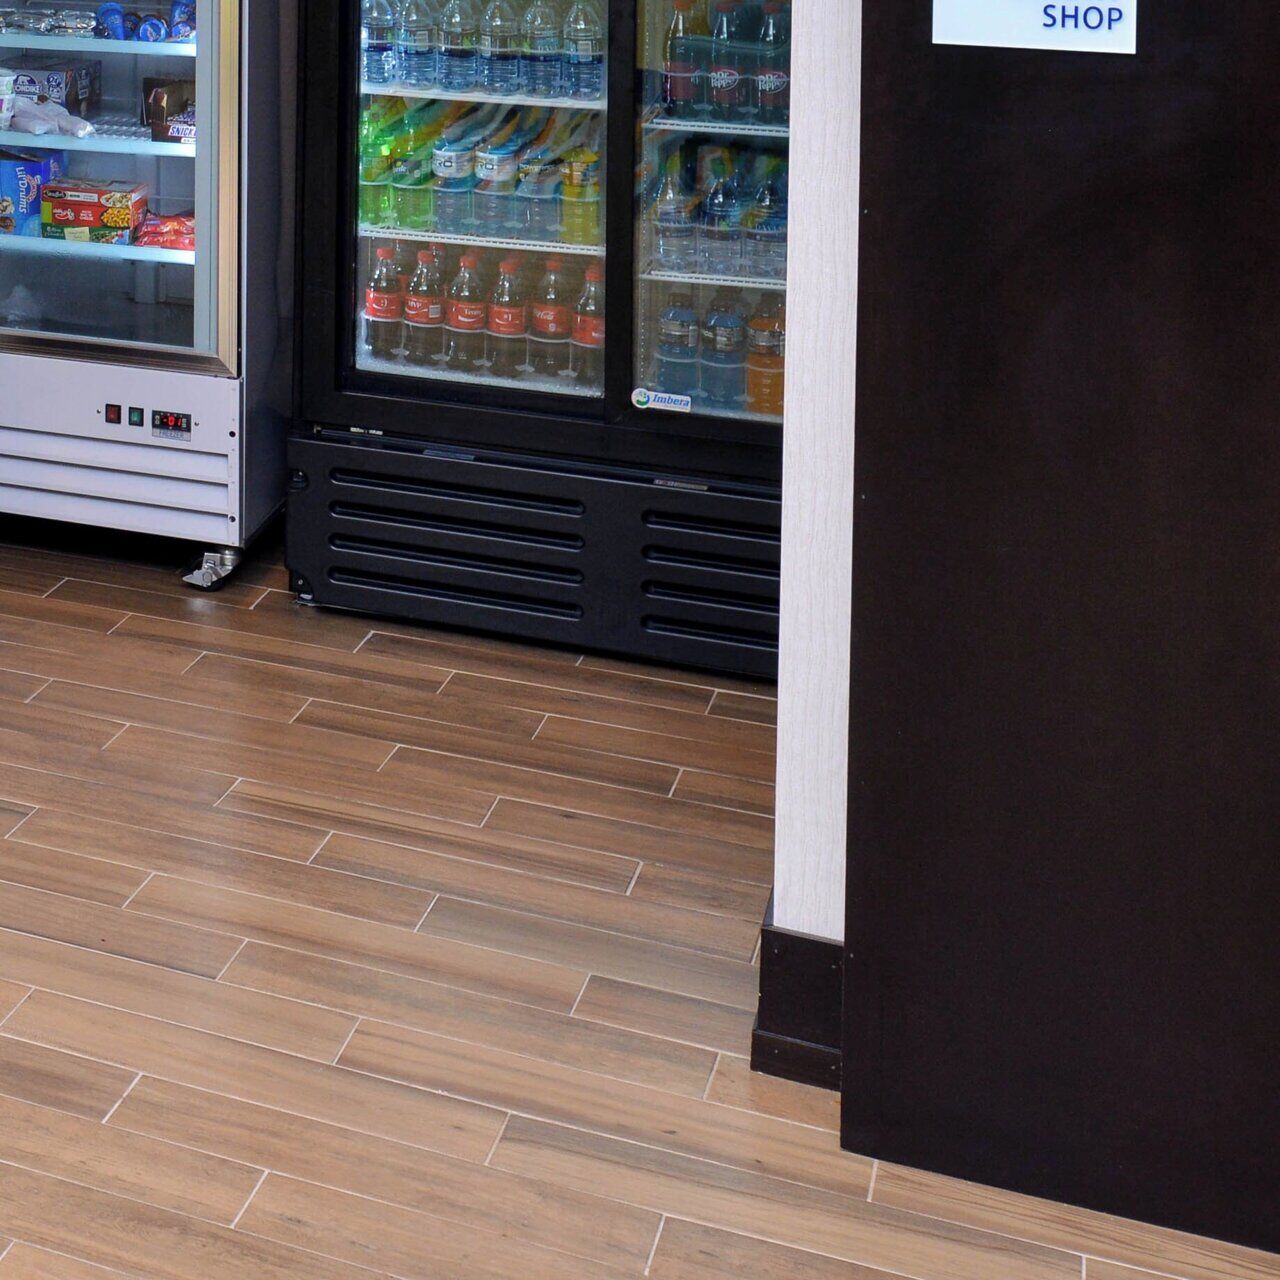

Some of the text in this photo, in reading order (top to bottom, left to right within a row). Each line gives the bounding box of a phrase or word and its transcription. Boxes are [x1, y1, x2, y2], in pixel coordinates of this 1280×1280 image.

[1042, 4, 1123, 30] SHOP
[14, 85, 41, 94] ONDIKE
[170, 125, 196, 137] SNICK
[652, 394, 690, 407] Imbera
